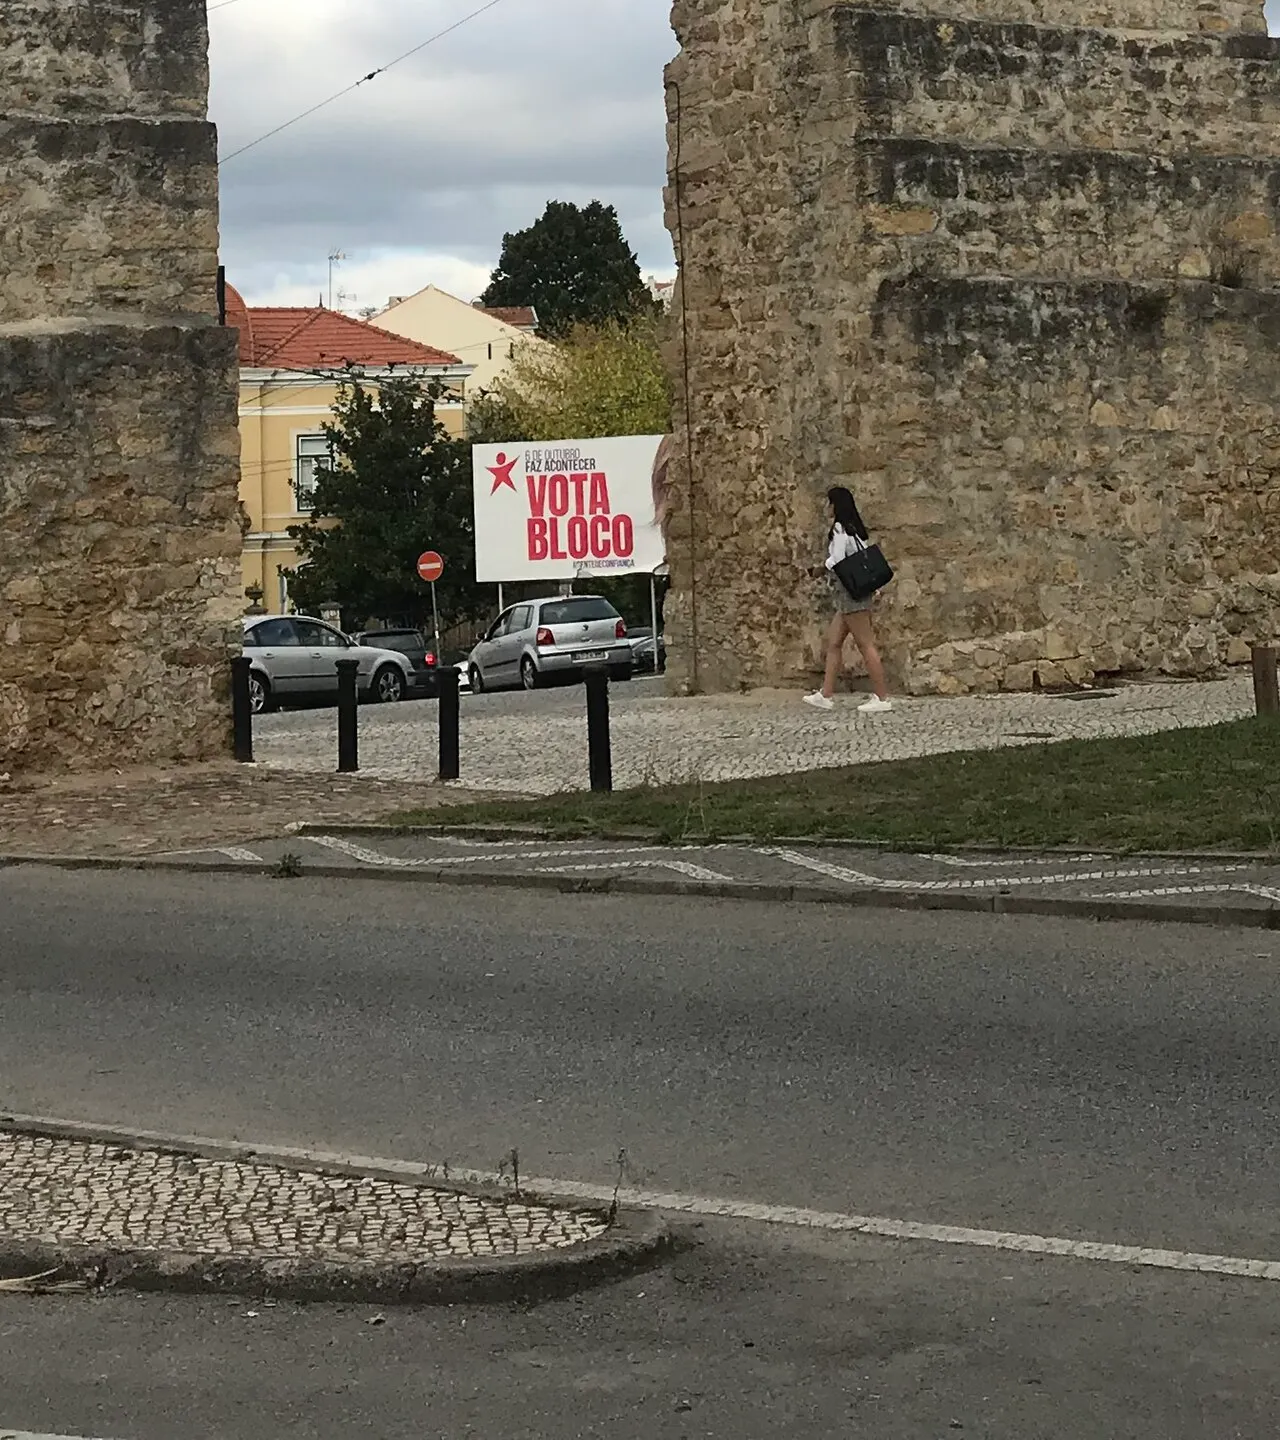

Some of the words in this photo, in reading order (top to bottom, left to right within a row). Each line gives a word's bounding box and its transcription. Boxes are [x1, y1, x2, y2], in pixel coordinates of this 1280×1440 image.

[525, 450, 531, 460] 6
[532, 449, 542, 460] DE
[544, 448, 580, 460] OUTUBRO
[525, 459, 542, 472] FAZ
[544, 458, 596, 472] ACONTECER
[526, 472, 610, 517] VOTA
[527, 514, 634, 560] BLOCO
